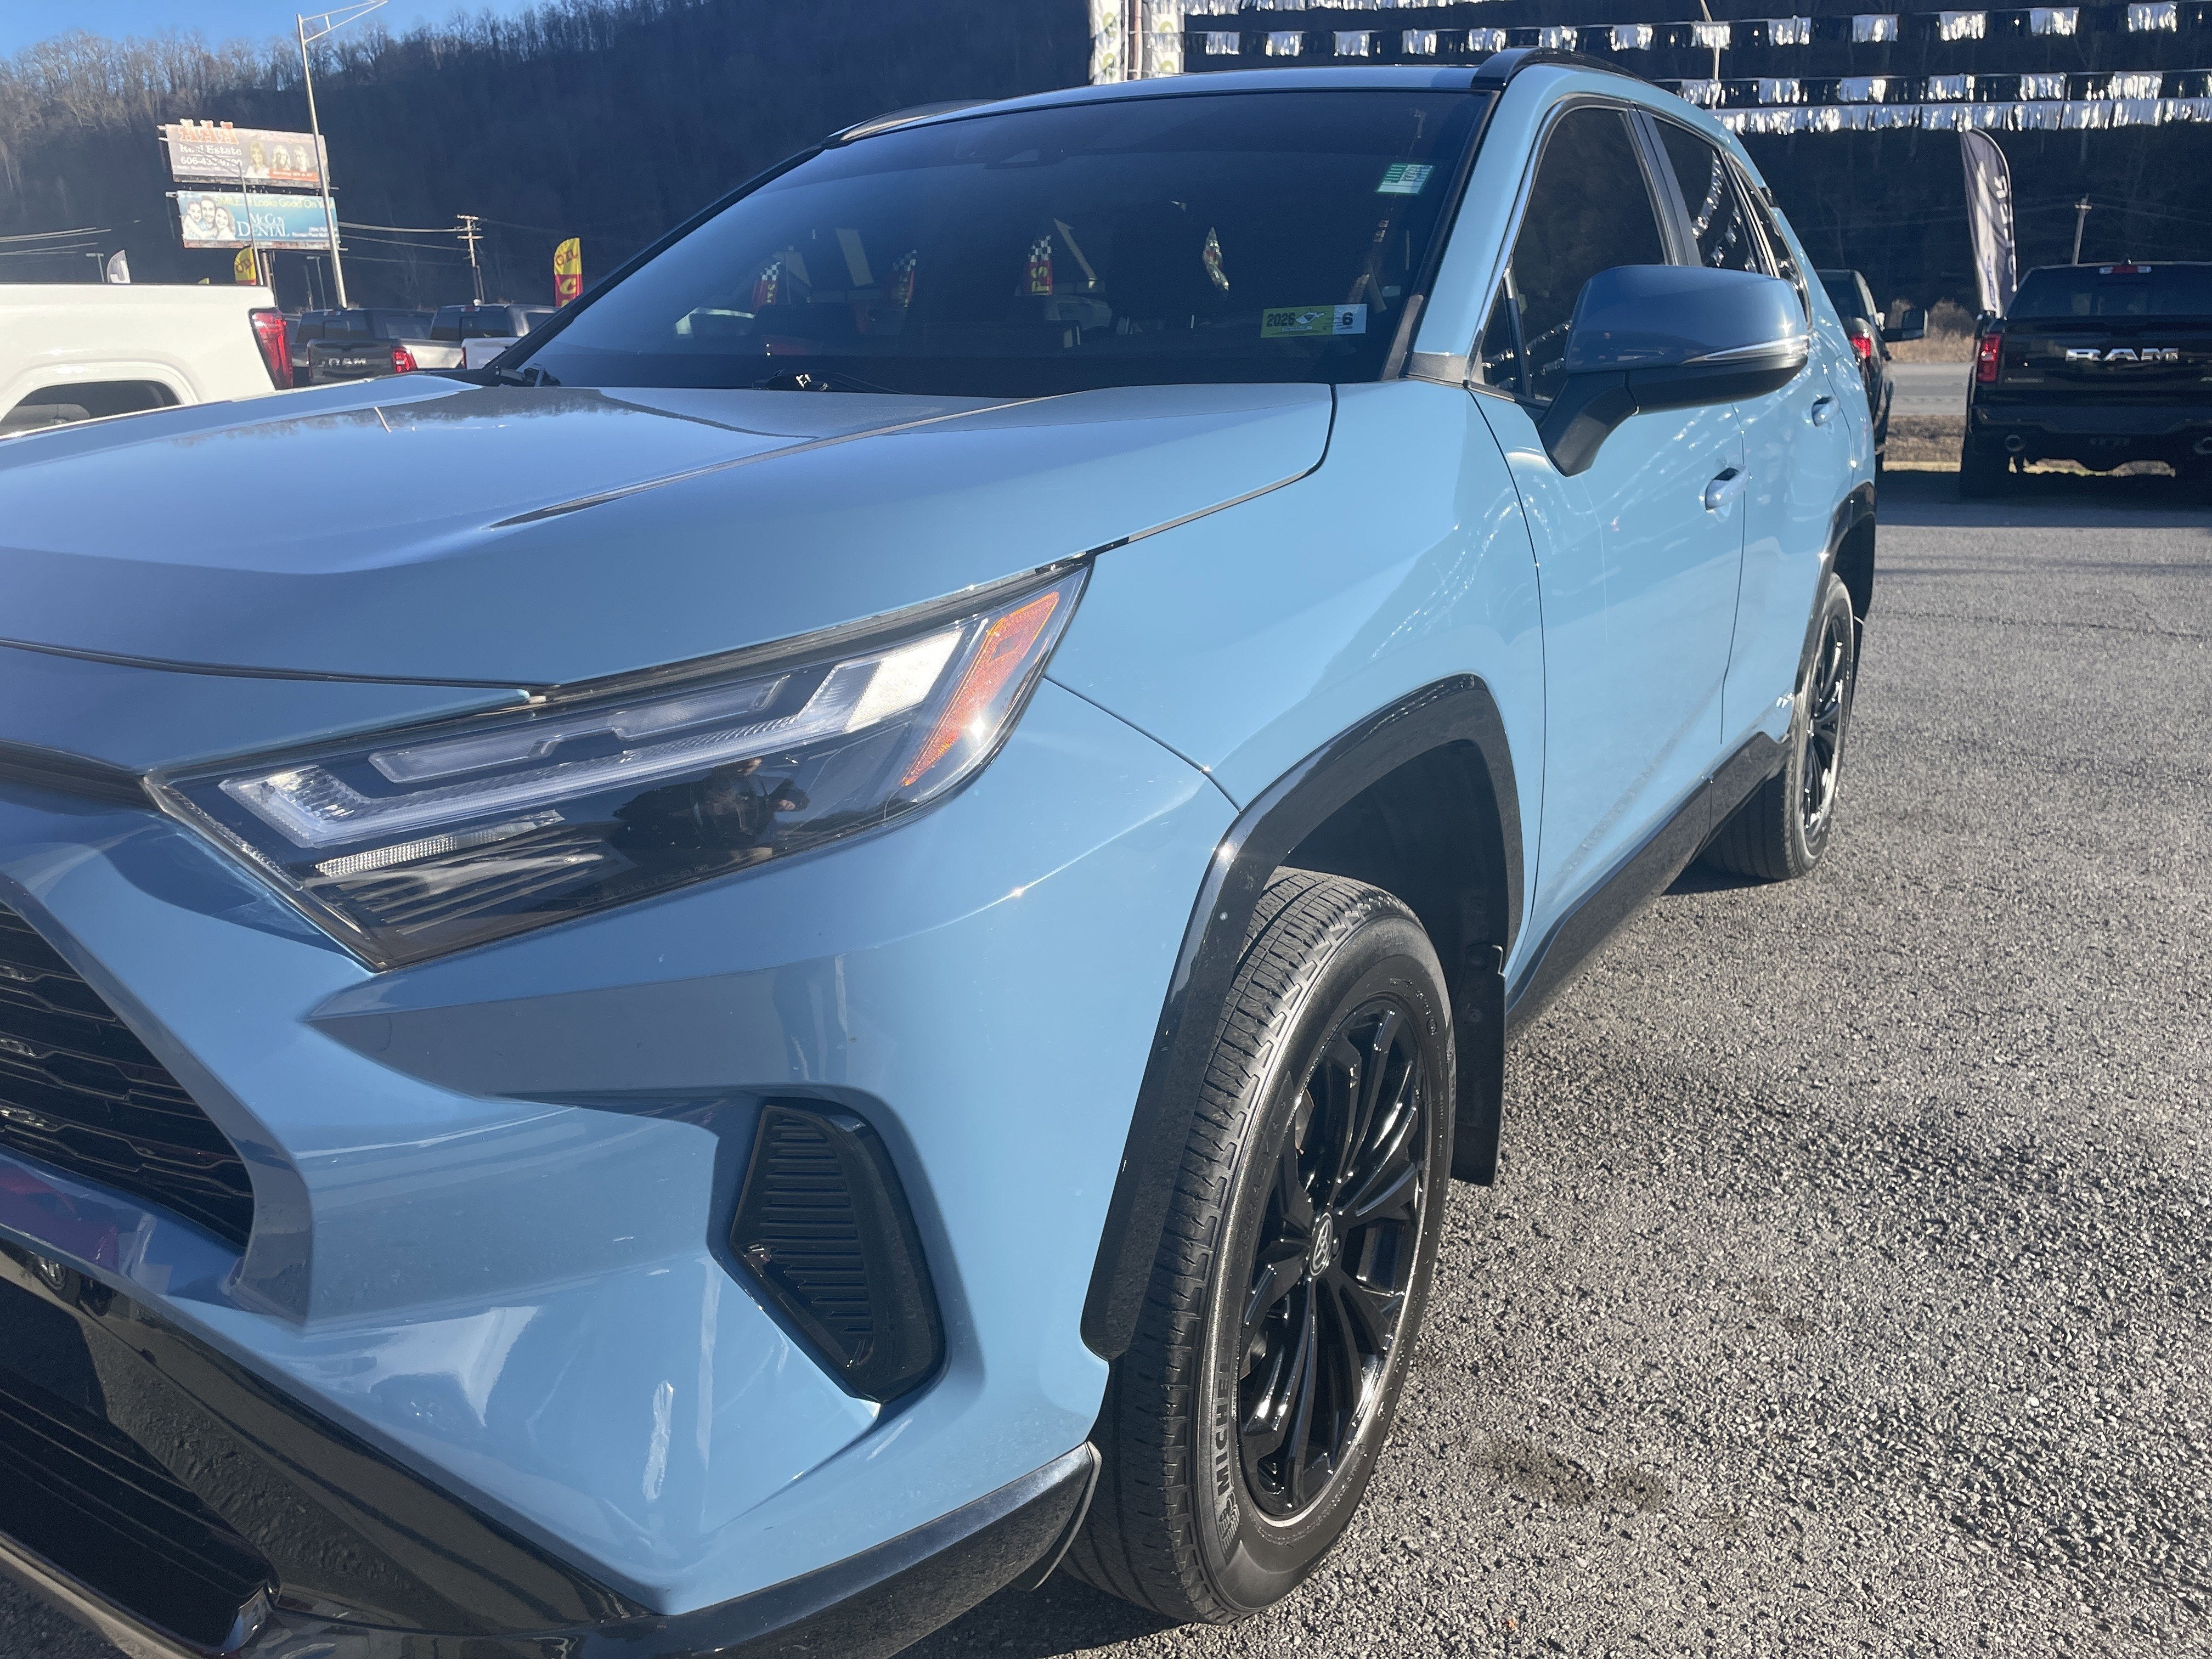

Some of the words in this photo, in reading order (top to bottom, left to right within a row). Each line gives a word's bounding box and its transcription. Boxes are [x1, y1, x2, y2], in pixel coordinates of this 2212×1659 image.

[206, 144, 242, 156] Estate
[236, 221, 290, 237] DENTAL
[1266, 312, 1296, 327] 2026
[1342, 312, 1354, 325] 6
[328, 358, 367, 366] RAM
[2066, 348, 2179, 362] RAM
